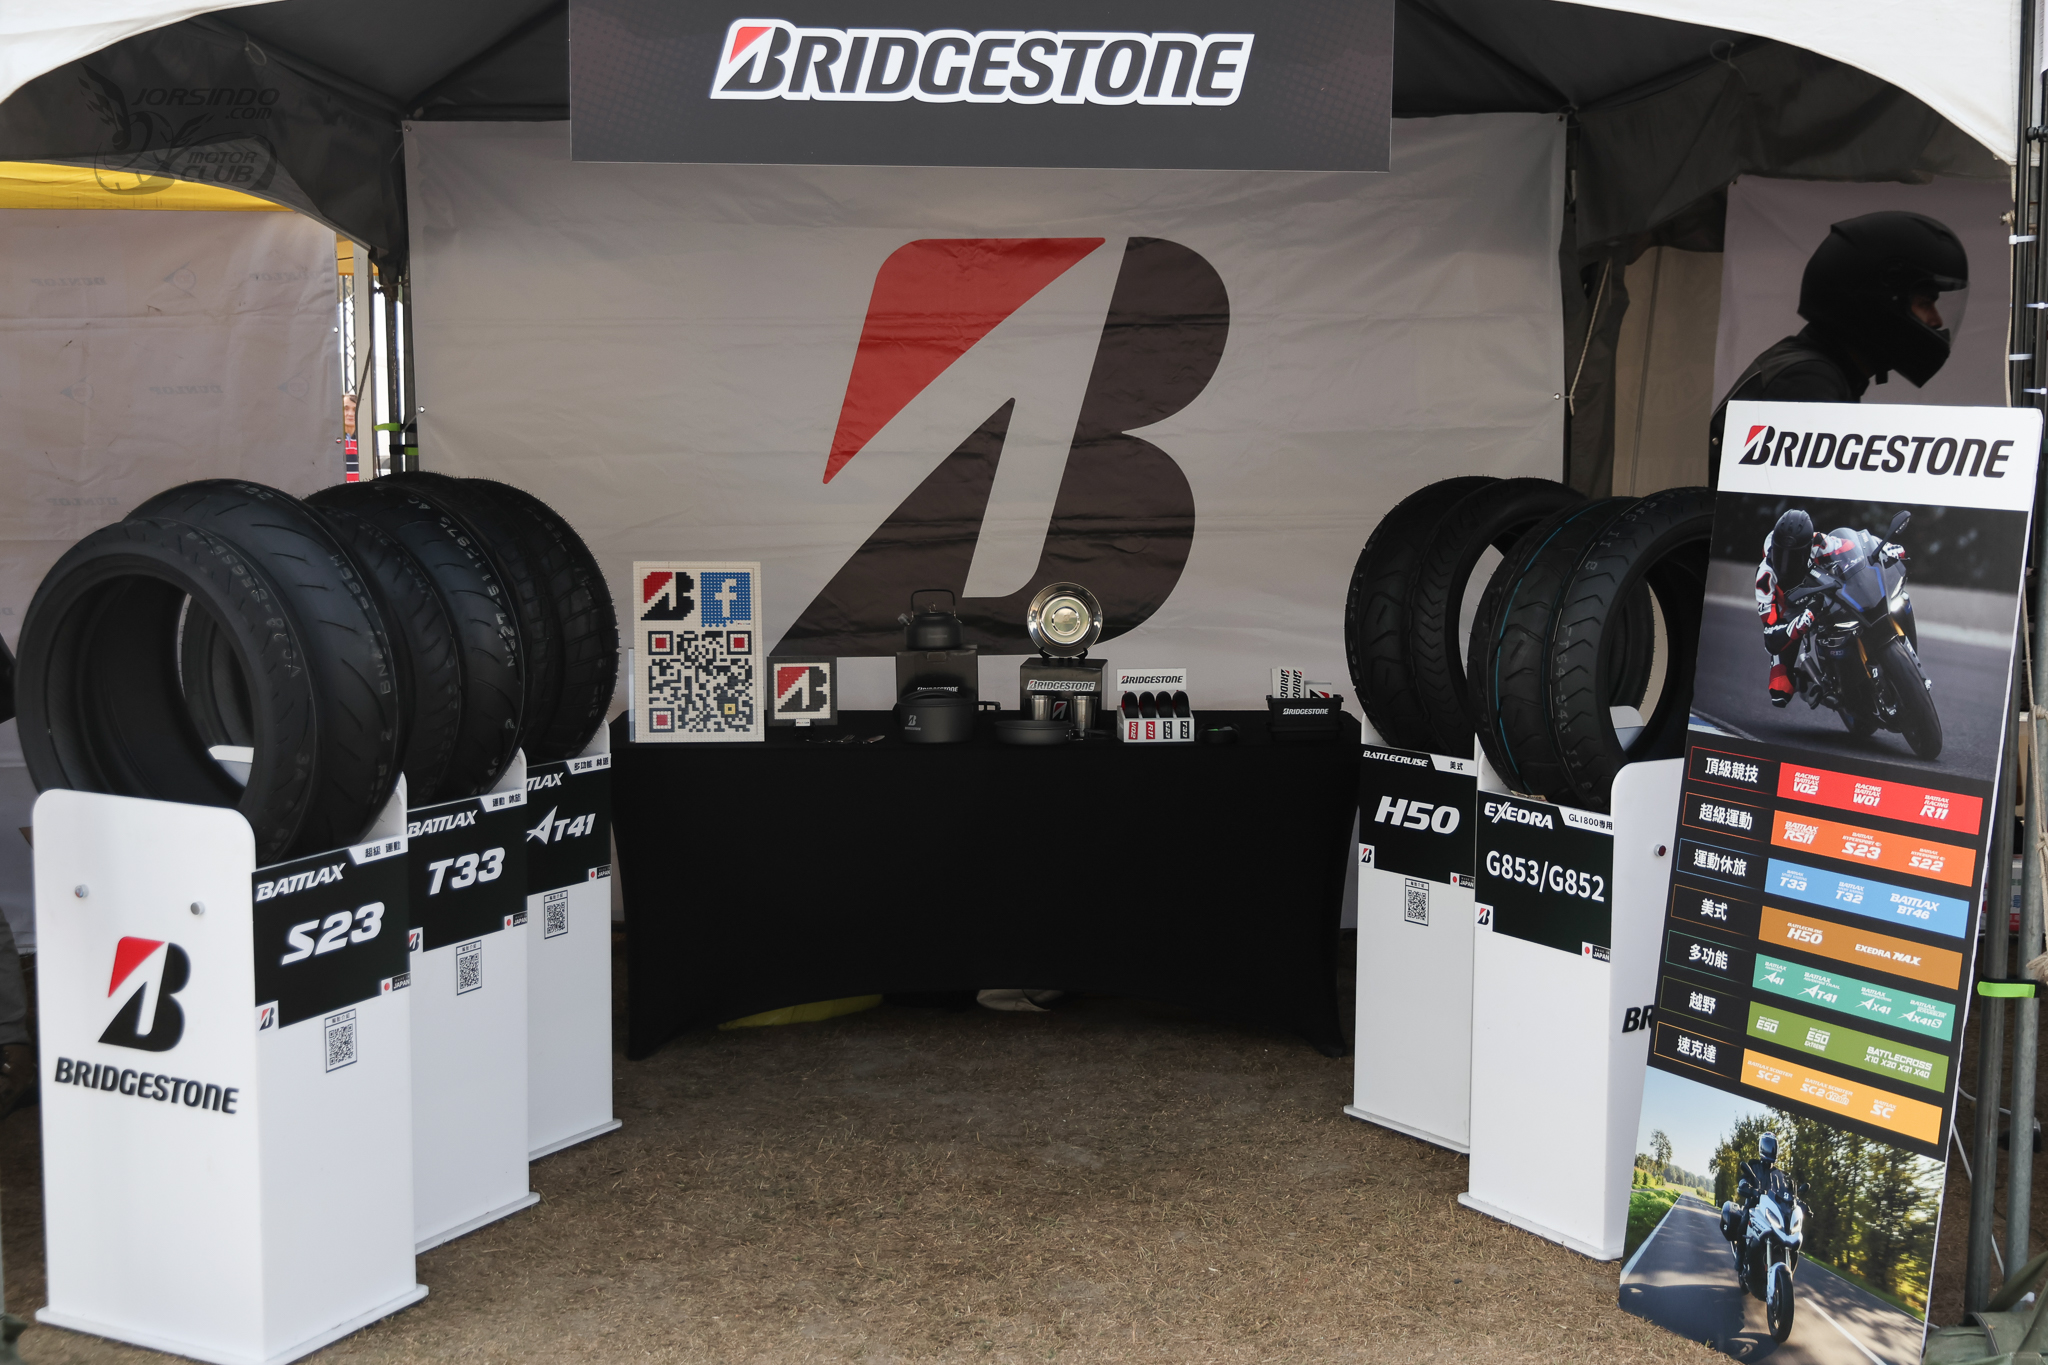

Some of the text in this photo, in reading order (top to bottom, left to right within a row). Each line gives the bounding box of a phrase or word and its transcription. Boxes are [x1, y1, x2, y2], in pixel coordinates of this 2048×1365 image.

[713, 20, 1253, 103] BRIDGESTONE
[1738, 425, 2015, 478] BRIDGESTONE
[1027, 679, 1096, 692] BRIDGESTONE
[1121, 675, 1184, 684] BRIDGESTONE
[1362, 750, 1429, 768] BATTLECRUISE
[1449, 761, 1464, 771] 美式
[1704, 756, 1759, 784] 頂級競技
[1794, 772, 1820, 781] RACING
[527, 772, 564, 791] TLAX
[1793, 782, 1819, 795] V02
[1855, 783, 1882, 792] RACING
[1852, 793, 1880, 807] W01
[1923, 800, 1949, 808] RACING
[1374, 795, 1461, 835] H50
[1484, 801, 1554, 830] EXEDRA
[1698, 802, 1753, 831] 超級運動
[1919, 805, 1949, 820] R11
[408, 809, 478, 838] BATTLAX
[526, 805, 596, 845] AT41
[1783, 830, 1815, 845] RS11
[365, 840, 401, 858] 超級 運動
[1841, 841, 1881, 860] S23
[428, 846, 506, 896] T33
[1693, 848, 1747, 877] 運動休旅
[1908, 855, 1944, 872] S22
[255, 862, 347, 902] BATTLAX
[1486, 850, 1605, 903] G853/G852
[1780, 876, 1807, 891] T33
[1835, 889, 1864, 904] T32
[1889, 892, 1940, 912] BATTLAX
[1700, 898, 1728, 922] 美式
[1896, 904, 1931, 920] BT46
[281, 901, 386, 966] S23
[1786, 927, 1823, 945] H50
[1593, 951, 1610, 961] JAPAN
[1688, 943, 1728, 970] 多功能
[1854, 943, 1922, 966] EXEDRA MAX
[393, 980, 410, 990] JAPAN
[1759, 971, 1785, 986] A41
[1688, 991, 1717, 1015] 越野
[1797, 984, 1838, 1004] AT41
[1854, 998, 1892, 1015] AX41
[1677, 1034, 1717, 1064] 速克達
[1866, 1045, 1933, 1071] BATTLECROSS
[1769, 1066, 1793, 1078] SCOOTER
[1864, 1054, 1931, 1079] X10 X20 X31 X40
[54, 1056, 240, 1115] BRIDGESTONE
[1756, 1069, 1781, 1084] SC2
[1800, 1083, 1826, 1098] SC2
[1828, 1084, 1853, 1096] SCOOTER
[1870, 1103, 1895, 1119] SC
